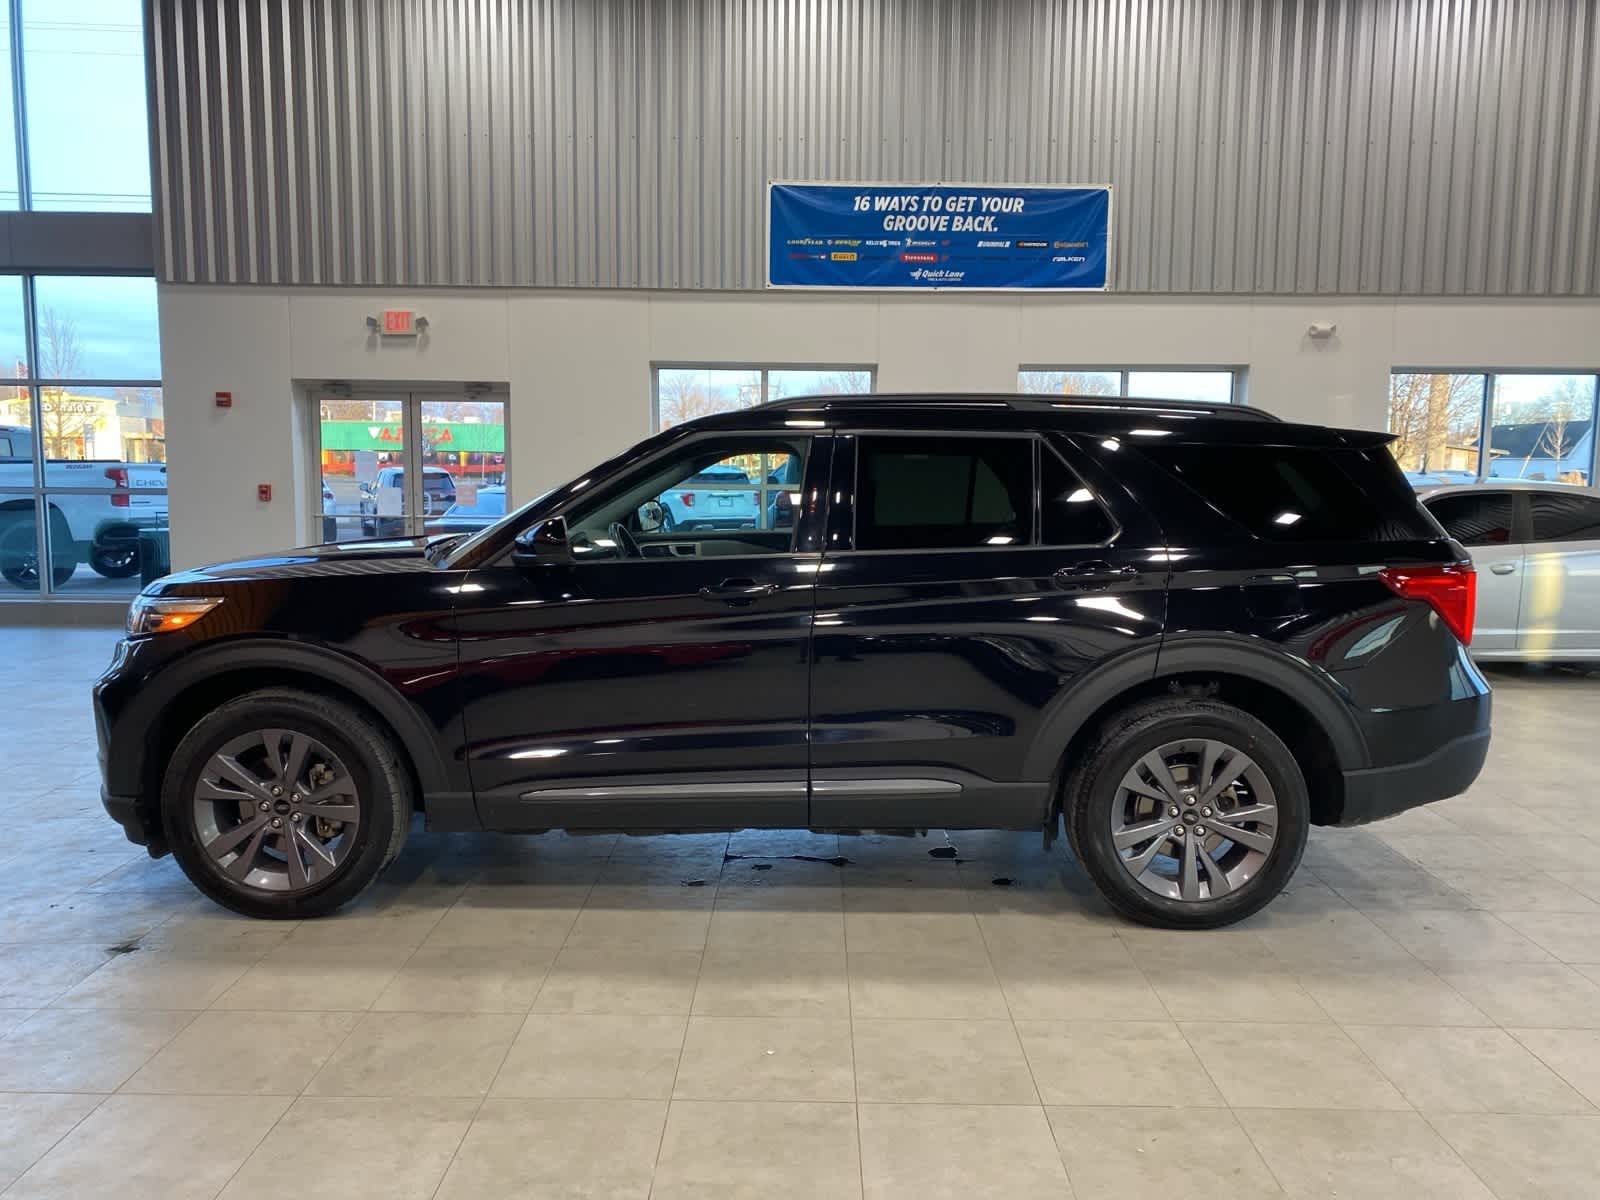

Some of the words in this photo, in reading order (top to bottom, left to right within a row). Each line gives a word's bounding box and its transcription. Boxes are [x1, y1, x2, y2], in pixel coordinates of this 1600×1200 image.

[854, 195, 870, 211] 16
[874, 196, 918, 212] WAYS
[922, 196, 942, 212] TO
[945, 196, 977, 212] GET
[981, 197, 1025, 213] YOUR
[883, 215, 949, 231] GROOVE
[951, 216, 998, 232] BACK.
[922, 269, 945, 278] Quick
[945, 270, 965, 278] Lane
[386, 311, 410, 330] EXIT
